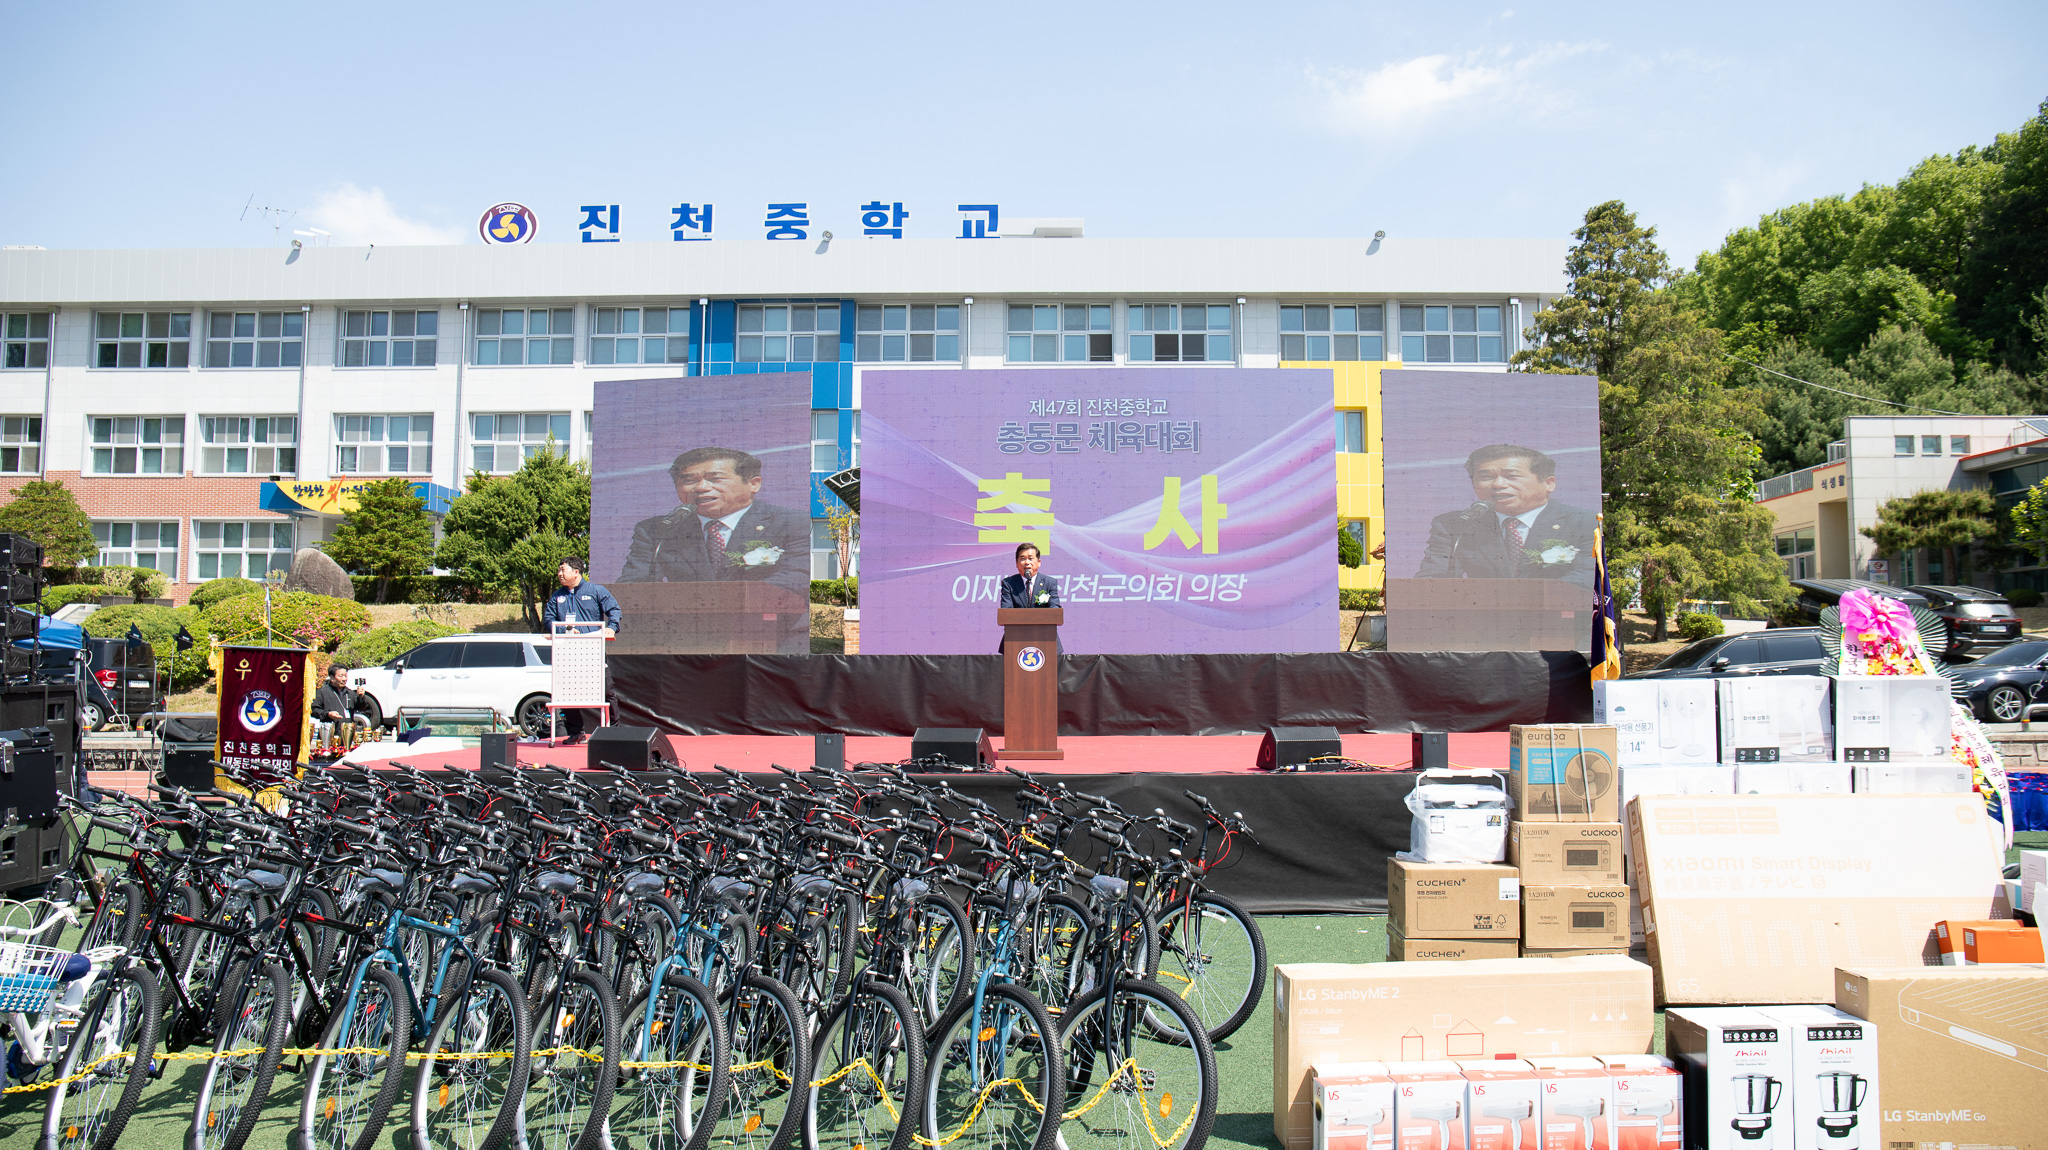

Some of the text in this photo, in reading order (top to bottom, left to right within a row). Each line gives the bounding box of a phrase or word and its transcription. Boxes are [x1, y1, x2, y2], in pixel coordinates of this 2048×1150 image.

[578, 201, 1000, 240] 진천중학교
[1029, 398, 1168, 417] 제47회 진천중학교
[997, 420, 1200, 454] 총동문 체육대회
[952, 574, 1247, 603] 이재 진천군의회 의장
[1635, 722, 1654, 731] 선풍기
[223, 741, 292, 756] 진천중학교
[1751, 856, 1804, 870] Smart
[1808, 856, 1872, 873] Display
[1678, 977, 1700, 994] 65
[1298, 987, 1400, 1002] LG StanbyME 2
[1401, 1086, 1414, 1097] VS
[1473, 1085, 1486, 1096] VS
[1546, 1083, 1558, 1094] VS
[1617, 1080, 1630, 1091] VS
[1328, 1090, 1340, 1101] VS
[1884, 1110, 1986, 1124] LG StanbyME Go
